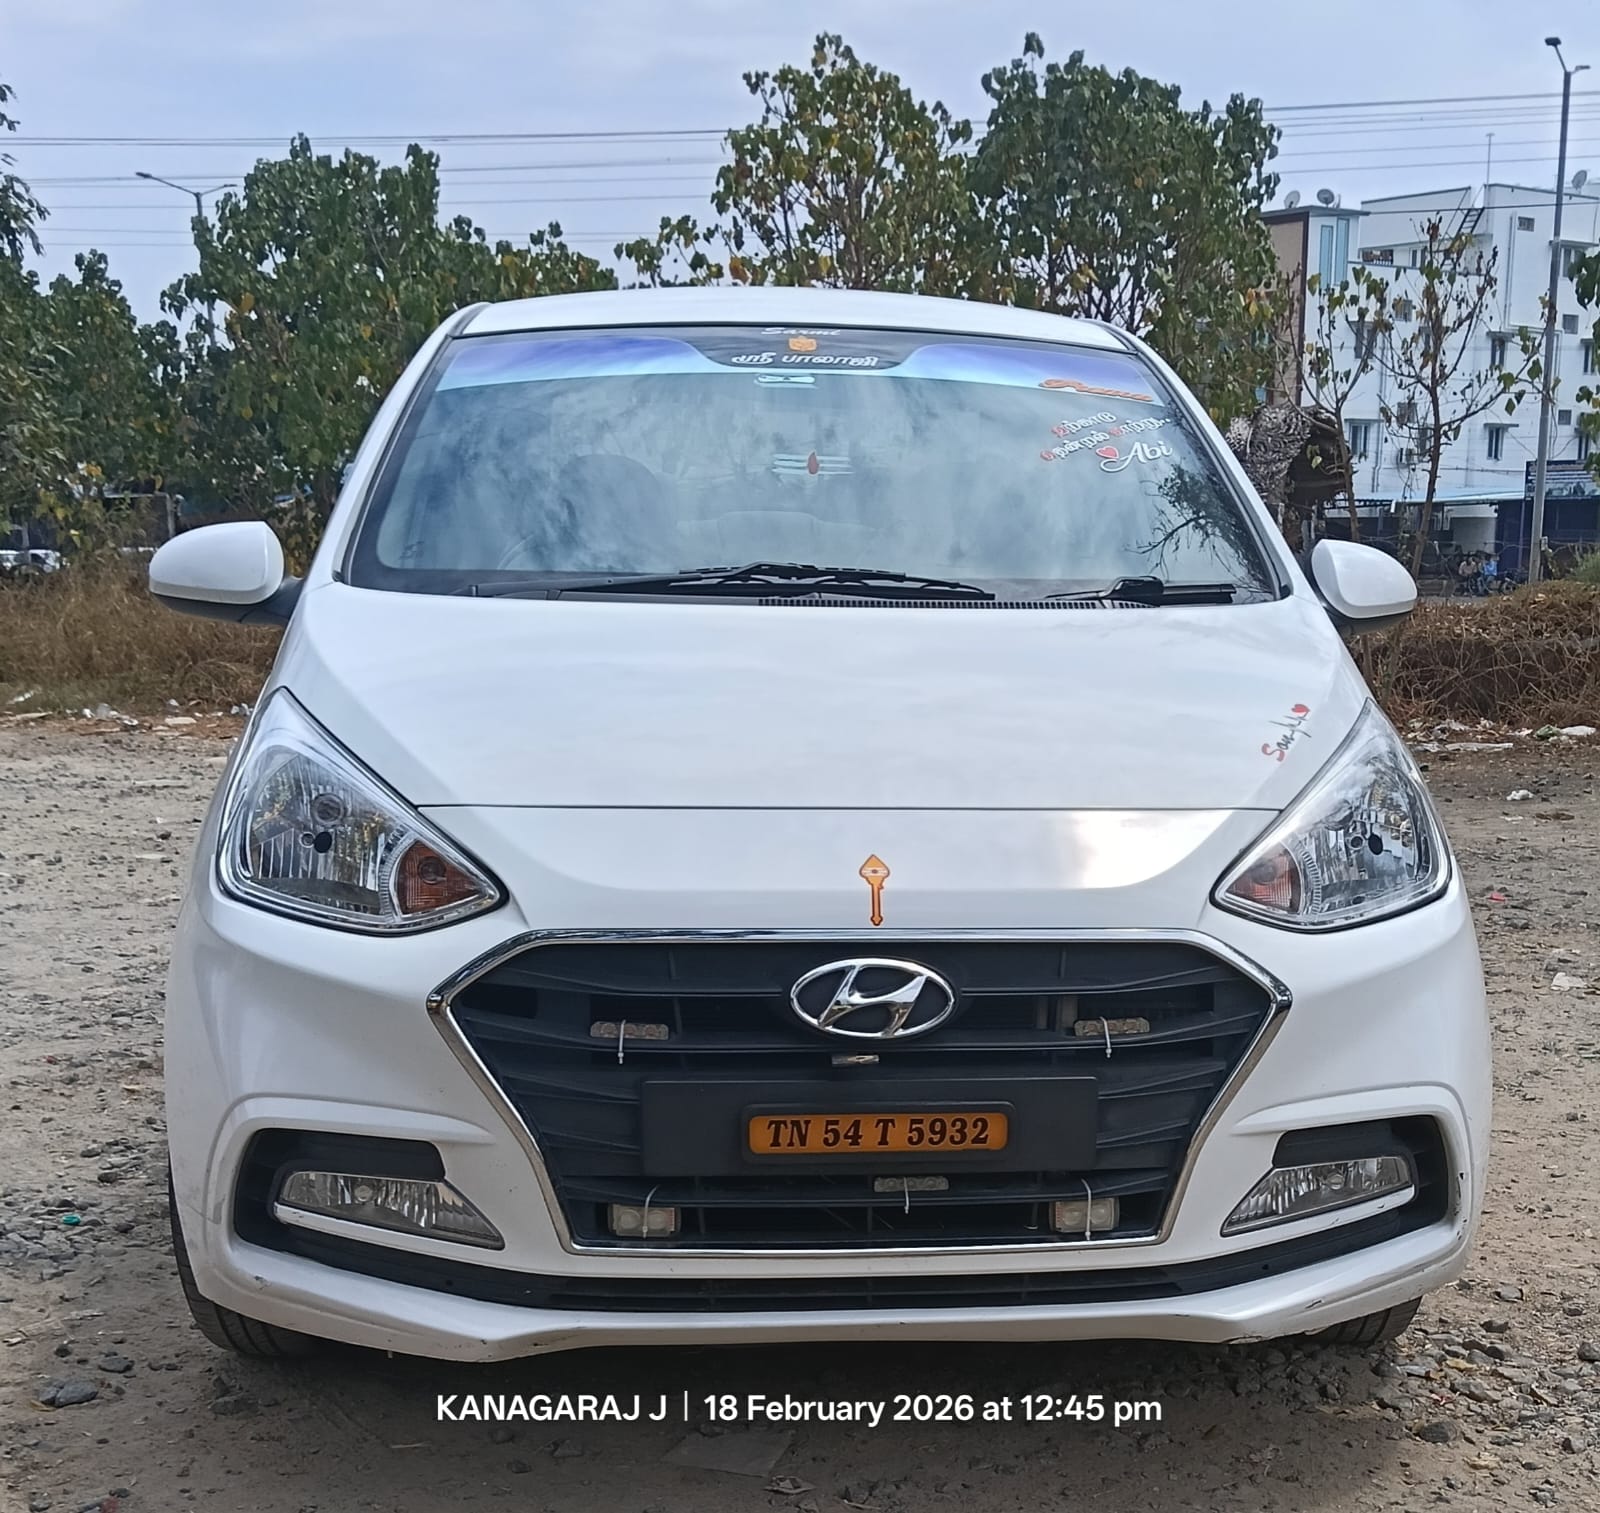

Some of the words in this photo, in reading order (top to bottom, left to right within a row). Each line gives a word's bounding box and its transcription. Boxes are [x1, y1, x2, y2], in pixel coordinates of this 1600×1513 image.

[781, 354, 880, 367] பாலாஜி
[1040, 430, 1110, 461] தென்றல்
[1099, 440, 1173, 473] Abi
[767, 1118, 812, 1148] TN
[822, 1118, 863, 1148] 54
[874, 1117, 896, 1147] T
[906, 1116, 990, 1146] 5932
